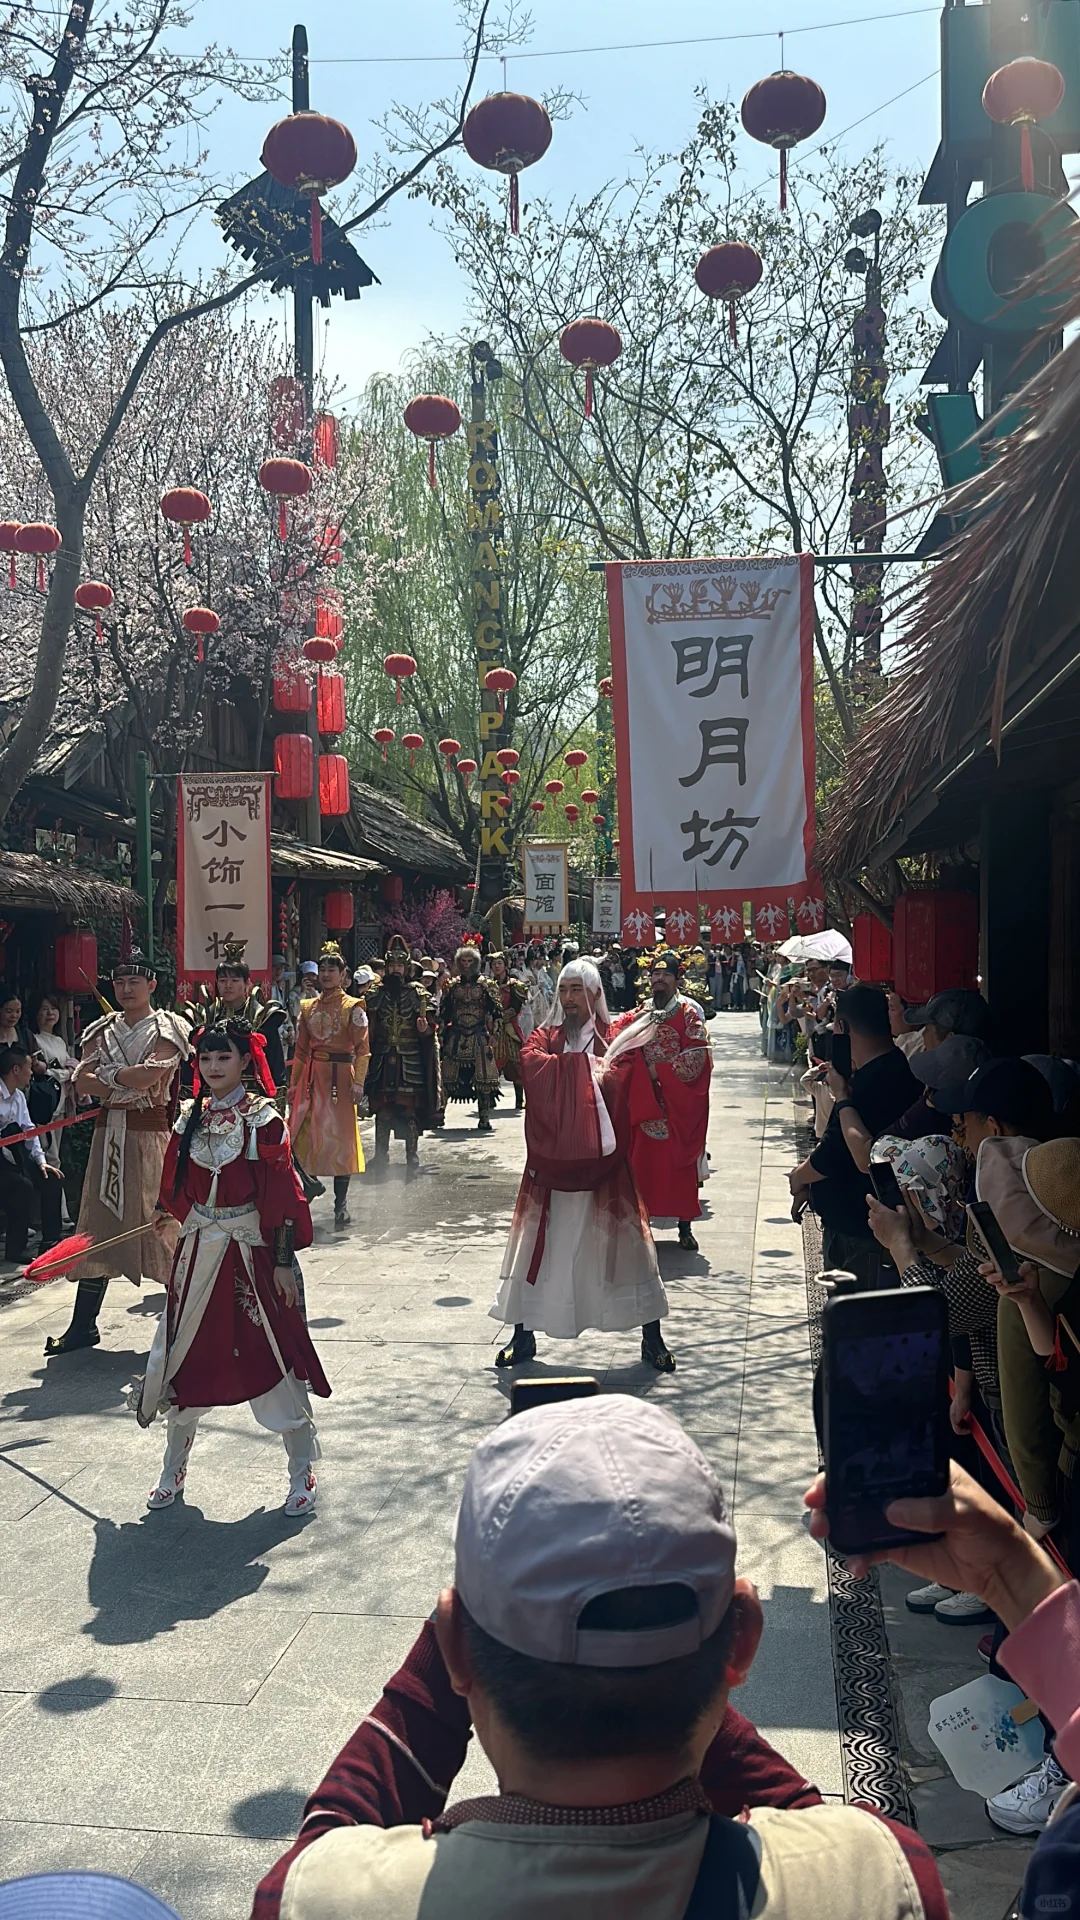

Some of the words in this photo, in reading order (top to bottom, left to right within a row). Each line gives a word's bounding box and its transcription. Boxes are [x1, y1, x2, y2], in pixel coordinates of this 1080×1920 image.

[467, 422, 502, 690] ROMANCE
[479, 712, 510, 856] PARK
[671, 635, 761, 870] 明月坊
[534, 873, 557, 913] 面馆
[599, 894, 613, 929] 土豆坊
